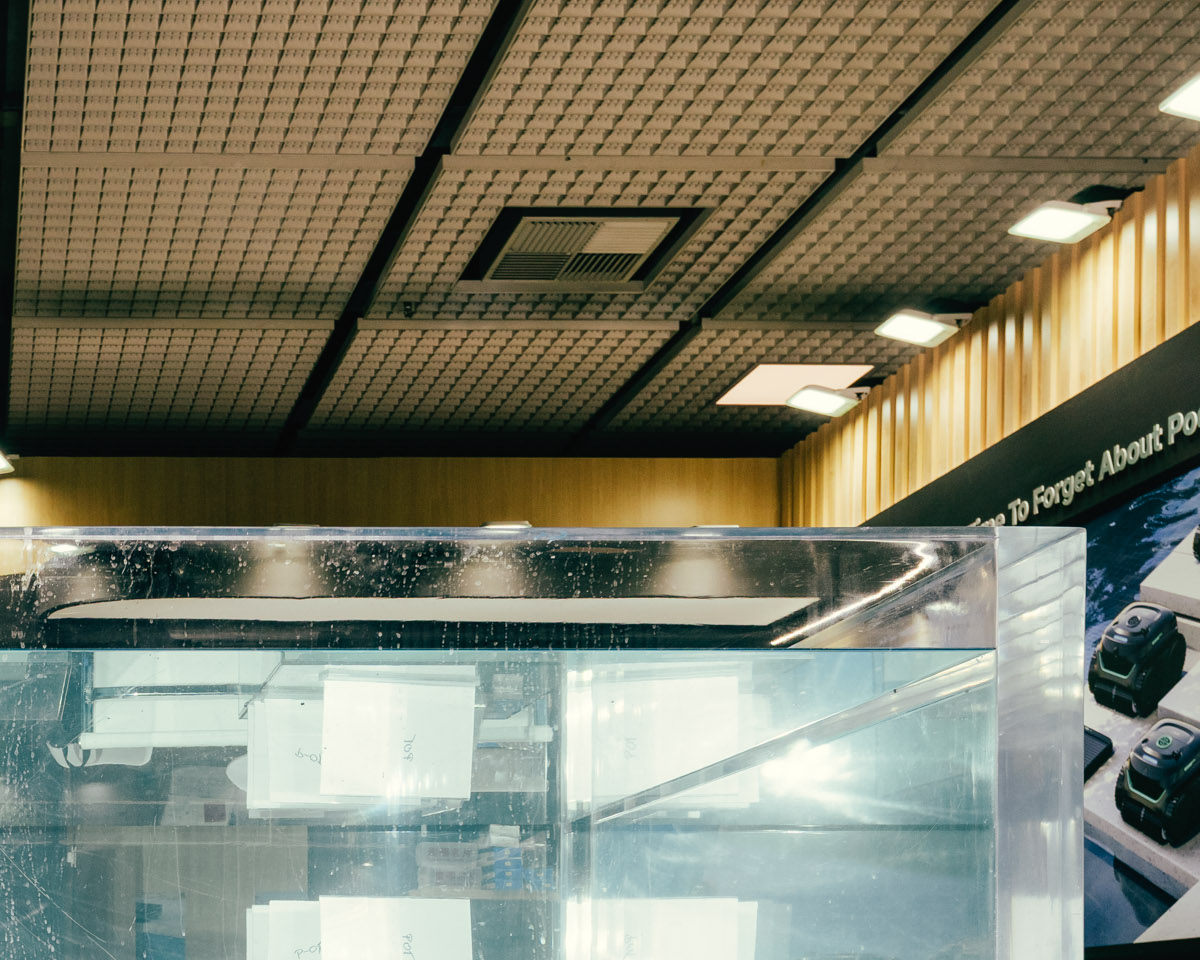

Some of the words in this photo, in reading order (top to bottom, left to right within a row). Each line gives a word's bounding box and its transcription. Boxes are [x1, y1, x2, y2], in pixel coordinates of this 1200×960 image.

[1008, 498, 1030, 526] To
[1032, 460, 1095, 515] Forget
[1098, 423, 1163, 482] About
[1167, 408, 1200, 445] Po
